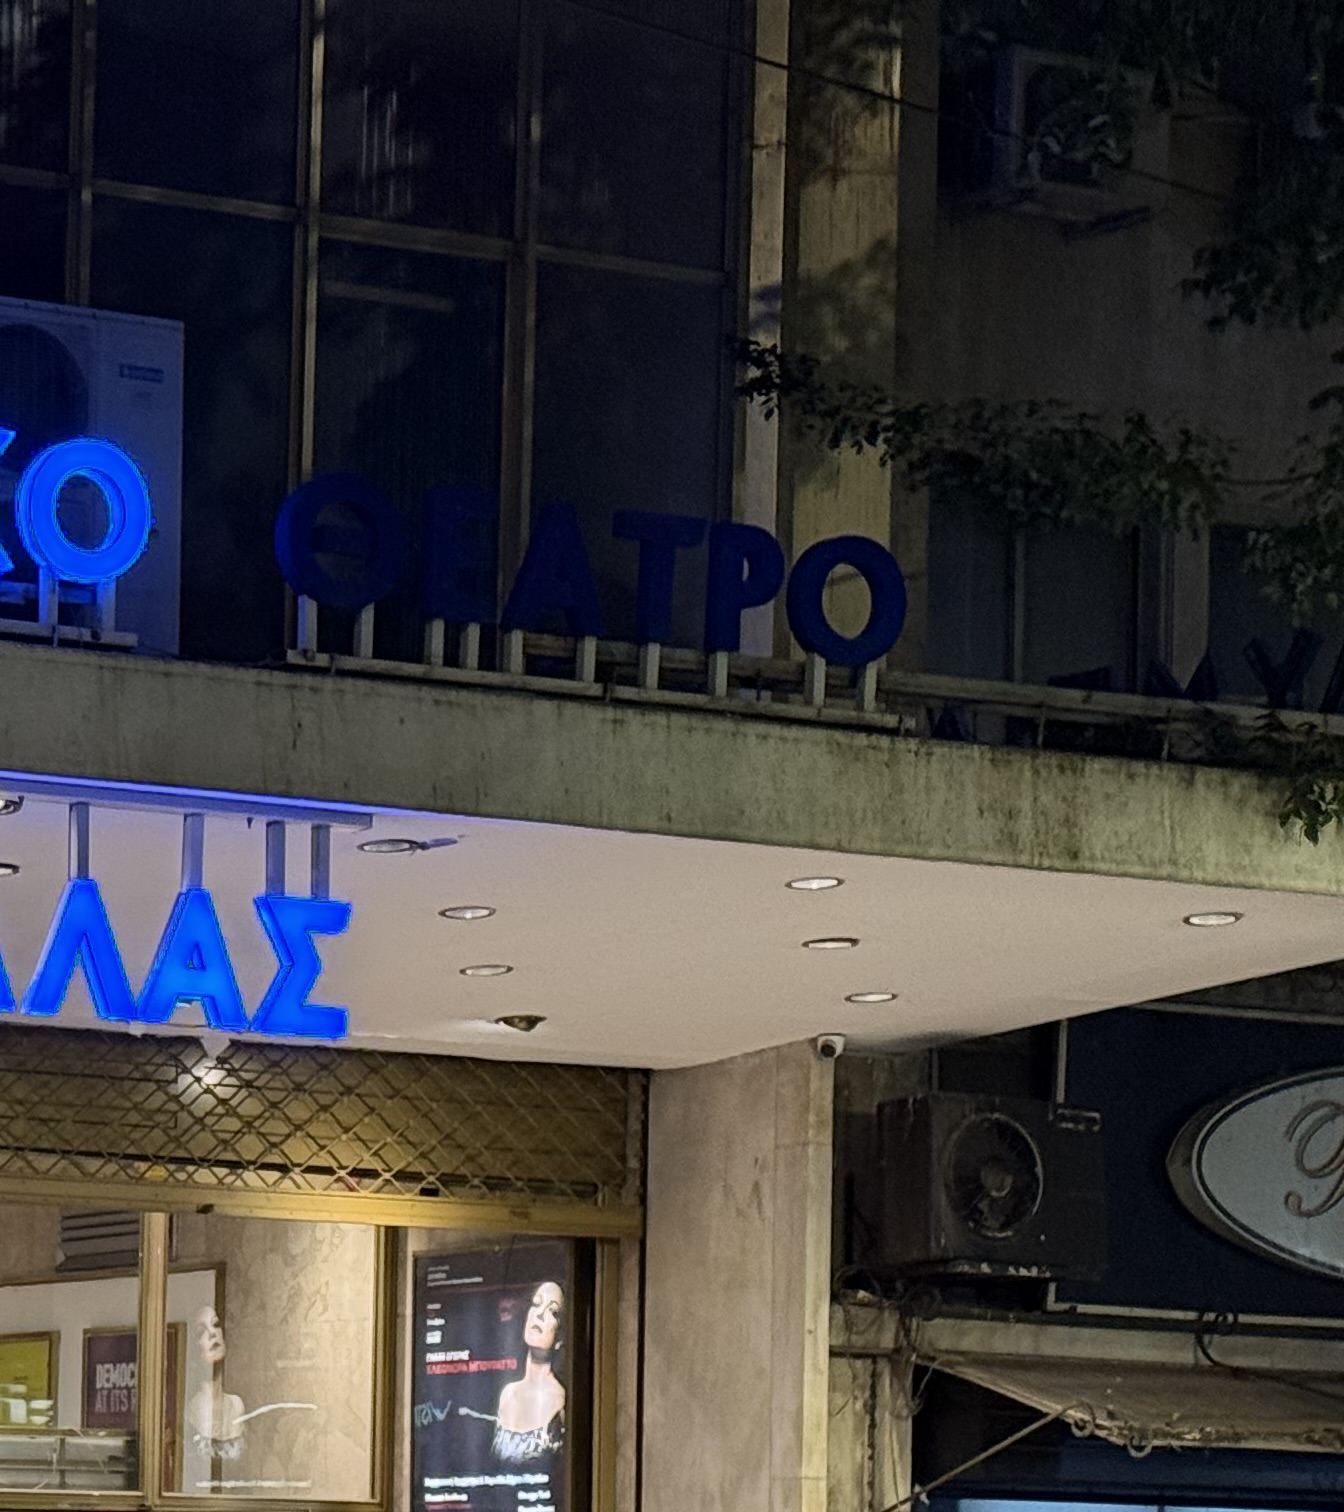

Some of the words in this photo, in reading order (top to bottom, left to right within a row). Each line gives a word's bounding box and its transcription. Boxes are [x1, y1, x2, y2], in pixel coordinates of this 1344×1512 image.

[273, 473, 908, 668] ΘΕΑΤΡΟ
[95, 1362, 137, 1390] DEMOC
[94, 1389, 108, 1413] AT
[110, 1389, 129, 1413] ITS
